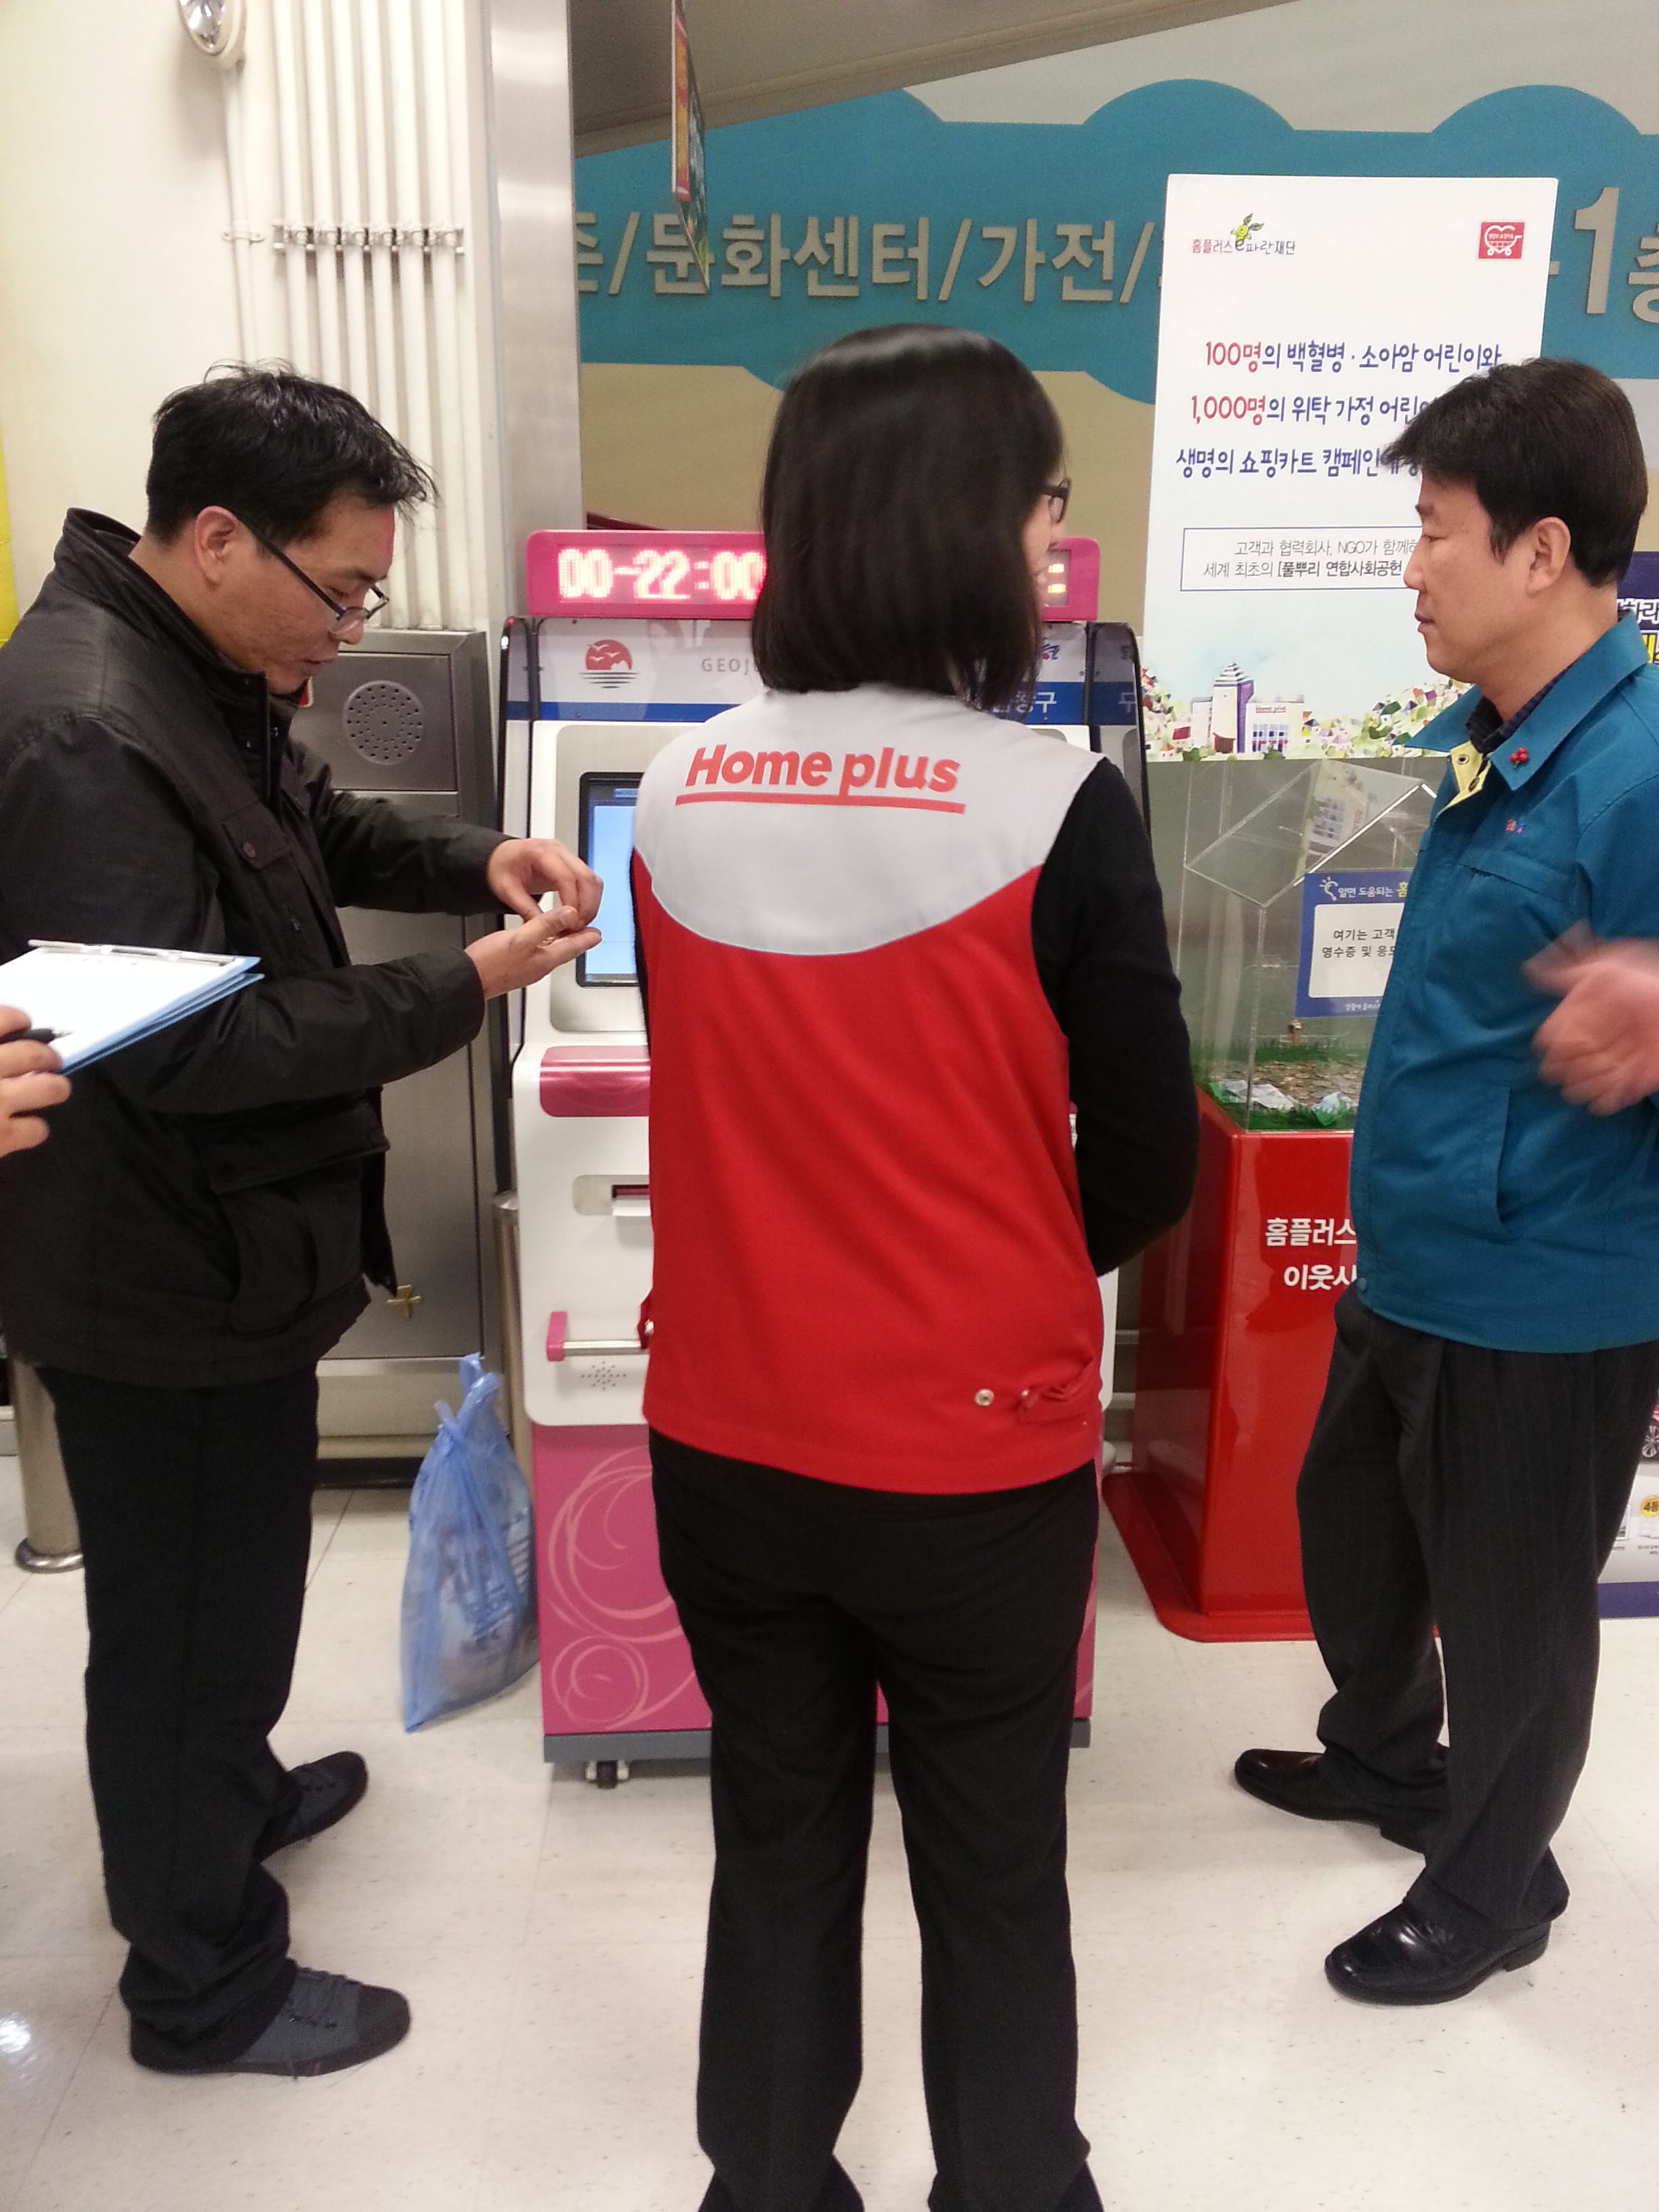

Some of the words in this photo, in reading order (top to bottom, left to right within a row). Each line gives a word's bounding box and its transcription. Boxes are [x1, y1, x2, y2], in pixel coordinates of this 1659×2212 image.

[1191, 239, 1233, 253] 홈플러스
[1206, 341, 1281, 373] 100명의
[1287, 340, 1345, 373] 백혈병
[1359, 343, 1420, 373] 소아암
[1423, 343, 1502, 373] 어린이와
[1191, 395, 1286, 426] 1,000명의
[1292, 395, 1332, 426] 위탁
[1335, 395, 1374, 426] 가정
[1379, 395, 1429, 425] 어린
[1176, 447, 1234, 478] 생명의
[1239, 447, 1317, 478] 쇼핑카트
[1234, 540, 1274, 556] 고객과
[1279, 539, 1332, 556] 협력회사,
[1338, 539, 1378, 556] NGO가
[1203, 562, 1230, 578] 세계
[1234, 561, 1273, 578] 최초의
[1277, 560, 1320, 577] [풀뿌리
[1326, 560, 1402, 577] 연합사회공헌
[686, 744, 832, 787] Home
[840, 747, 961, 797] plus
[1357, 886, 1394, 898] 도움되는
[1333, 929, 1368, 941] 여기는
[1372, 928, 1395, 940] 고객
[1322, 945, 1356, 959] 영수증
[1361, 945, 1372, 958] 및
[1265, 1216, 1357, 1247] 홈플러스
